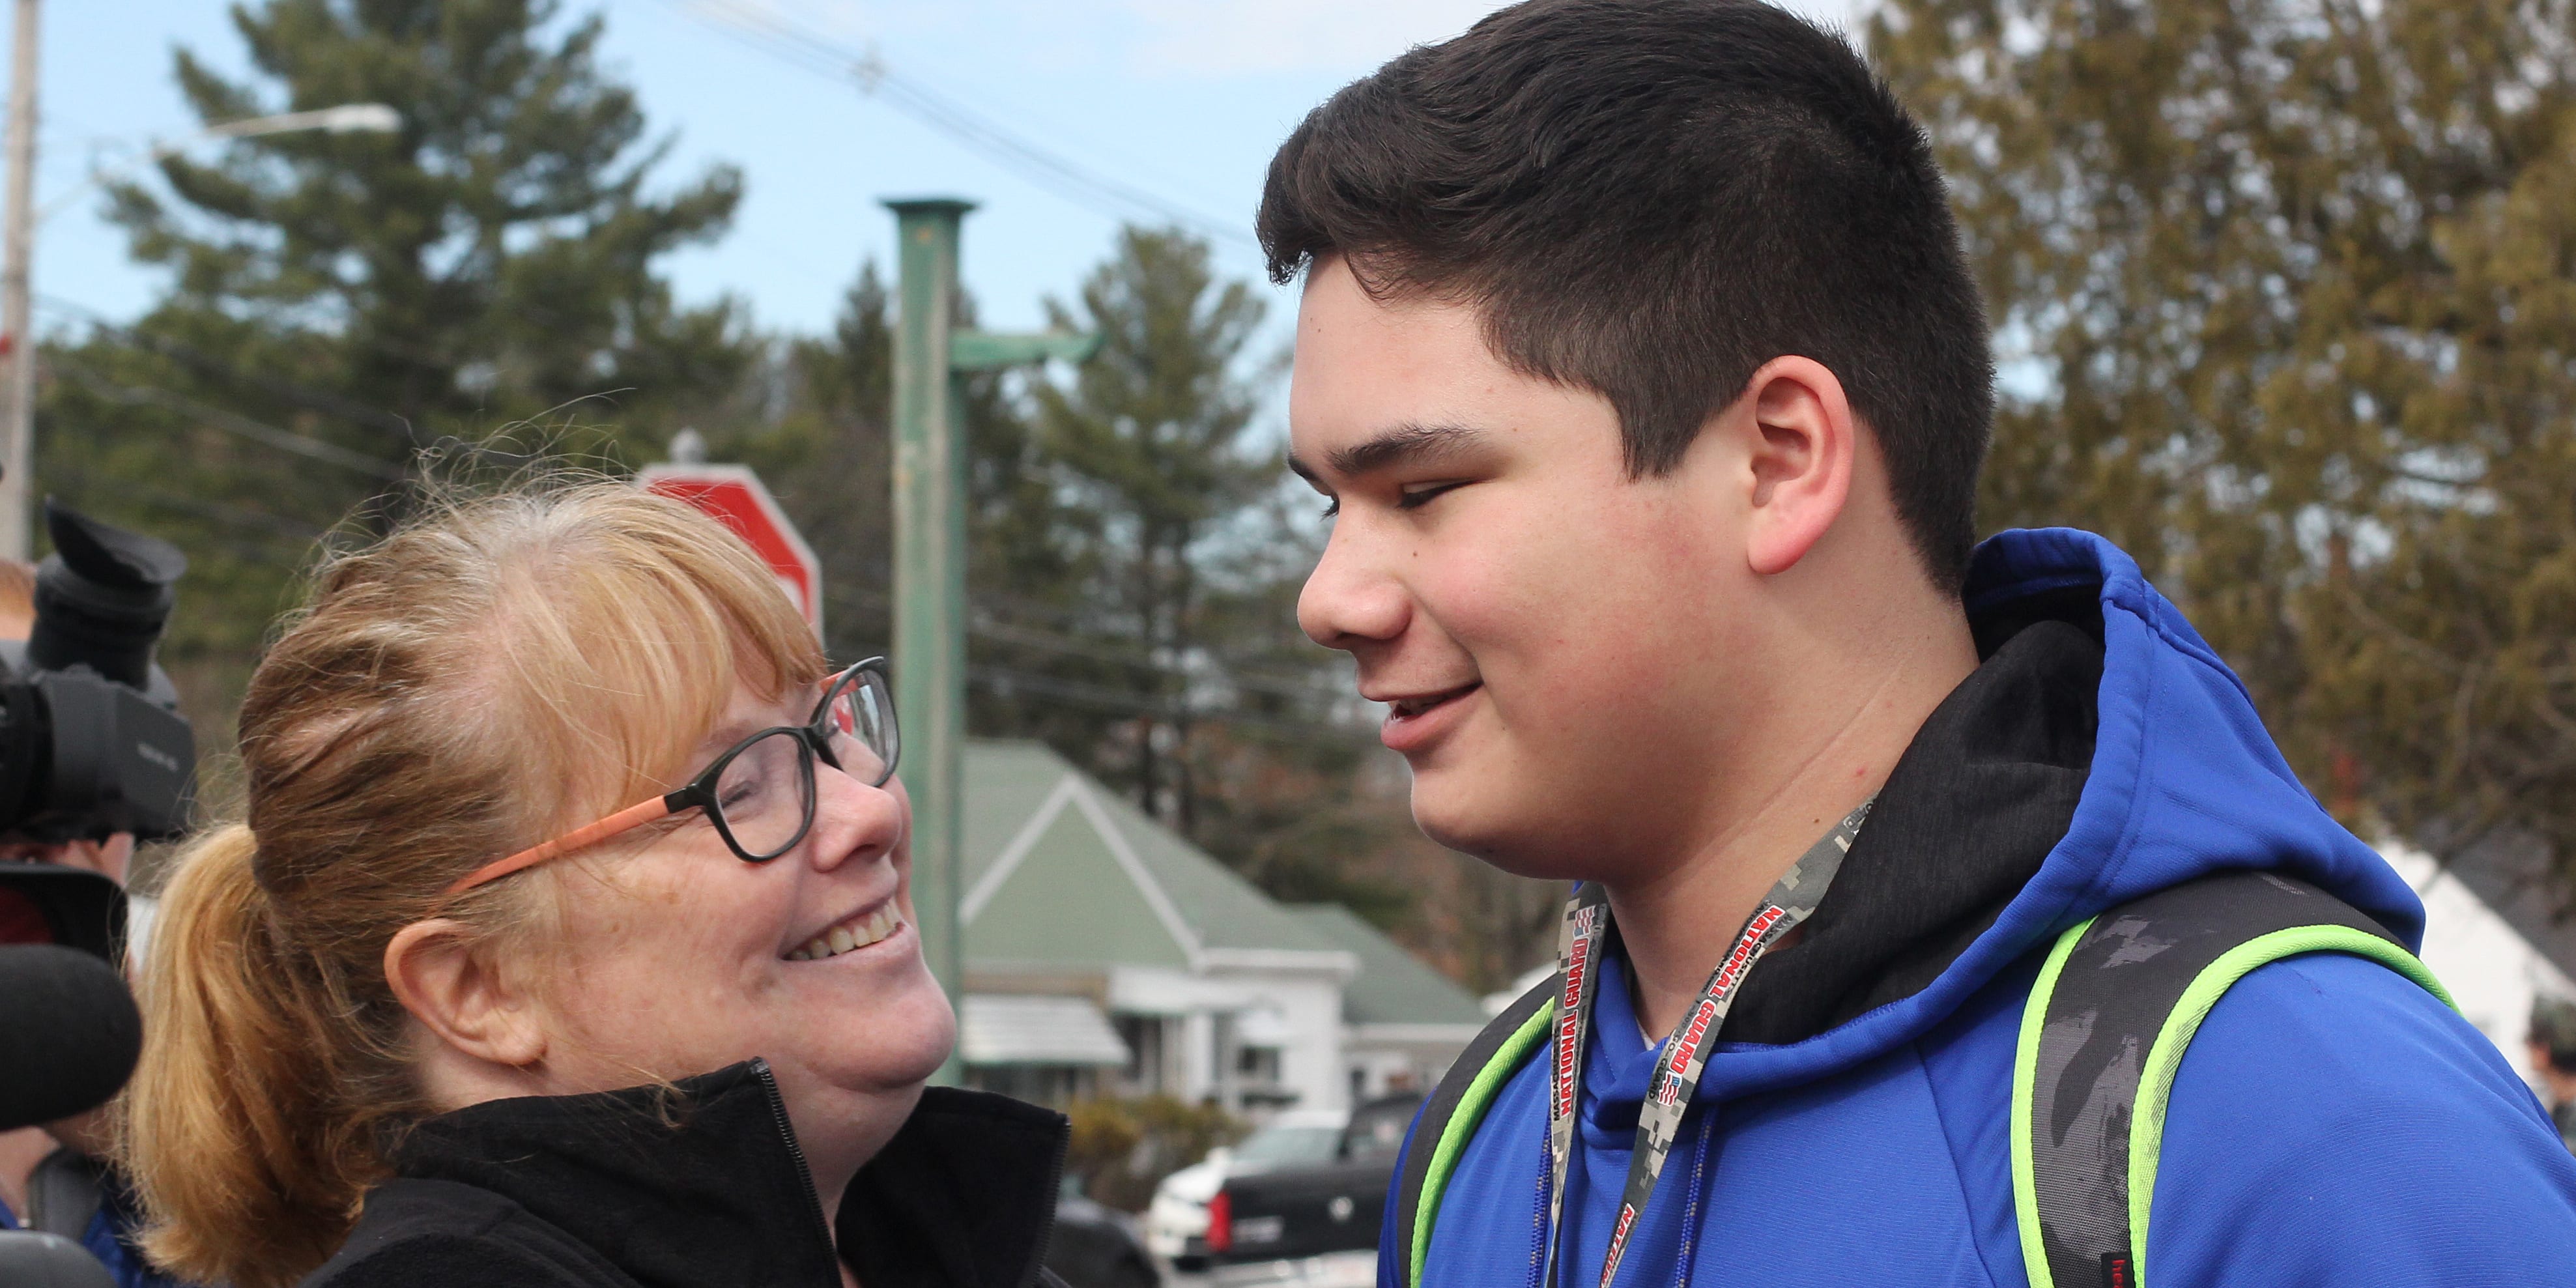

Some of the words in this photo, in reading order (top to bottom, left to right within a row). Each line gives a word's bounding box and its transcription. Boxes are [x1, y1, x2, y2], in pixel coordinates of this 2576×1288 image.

[1564, 937, 1589, 1009] GUARD
[1709, 906, 1784, 997] NATIONAL
[1560, 1010, 1577, 1117] NATIONAL
[1670, 1000, 1715, 1074] GUARD
